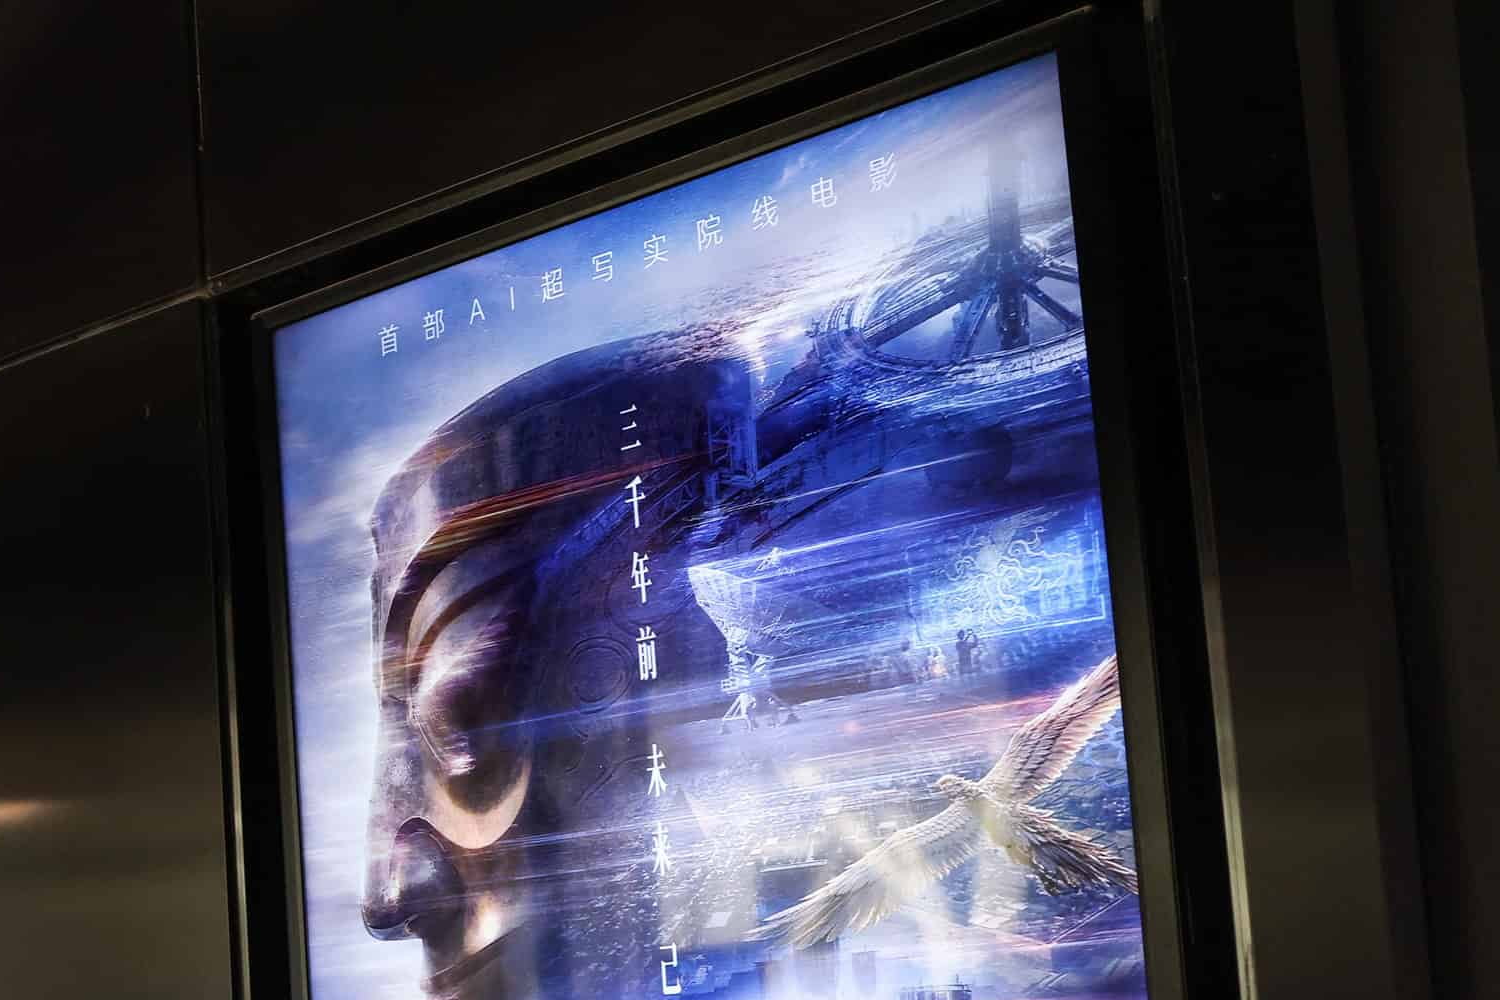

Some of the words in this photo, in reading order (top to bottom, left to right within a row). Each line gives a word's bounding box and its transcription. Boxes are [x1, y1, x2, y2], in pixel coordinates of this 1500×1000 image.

[378, 152, 897, 357] 首部AI超写实院线电影
[619, 403, 658, 681] 三千年前
